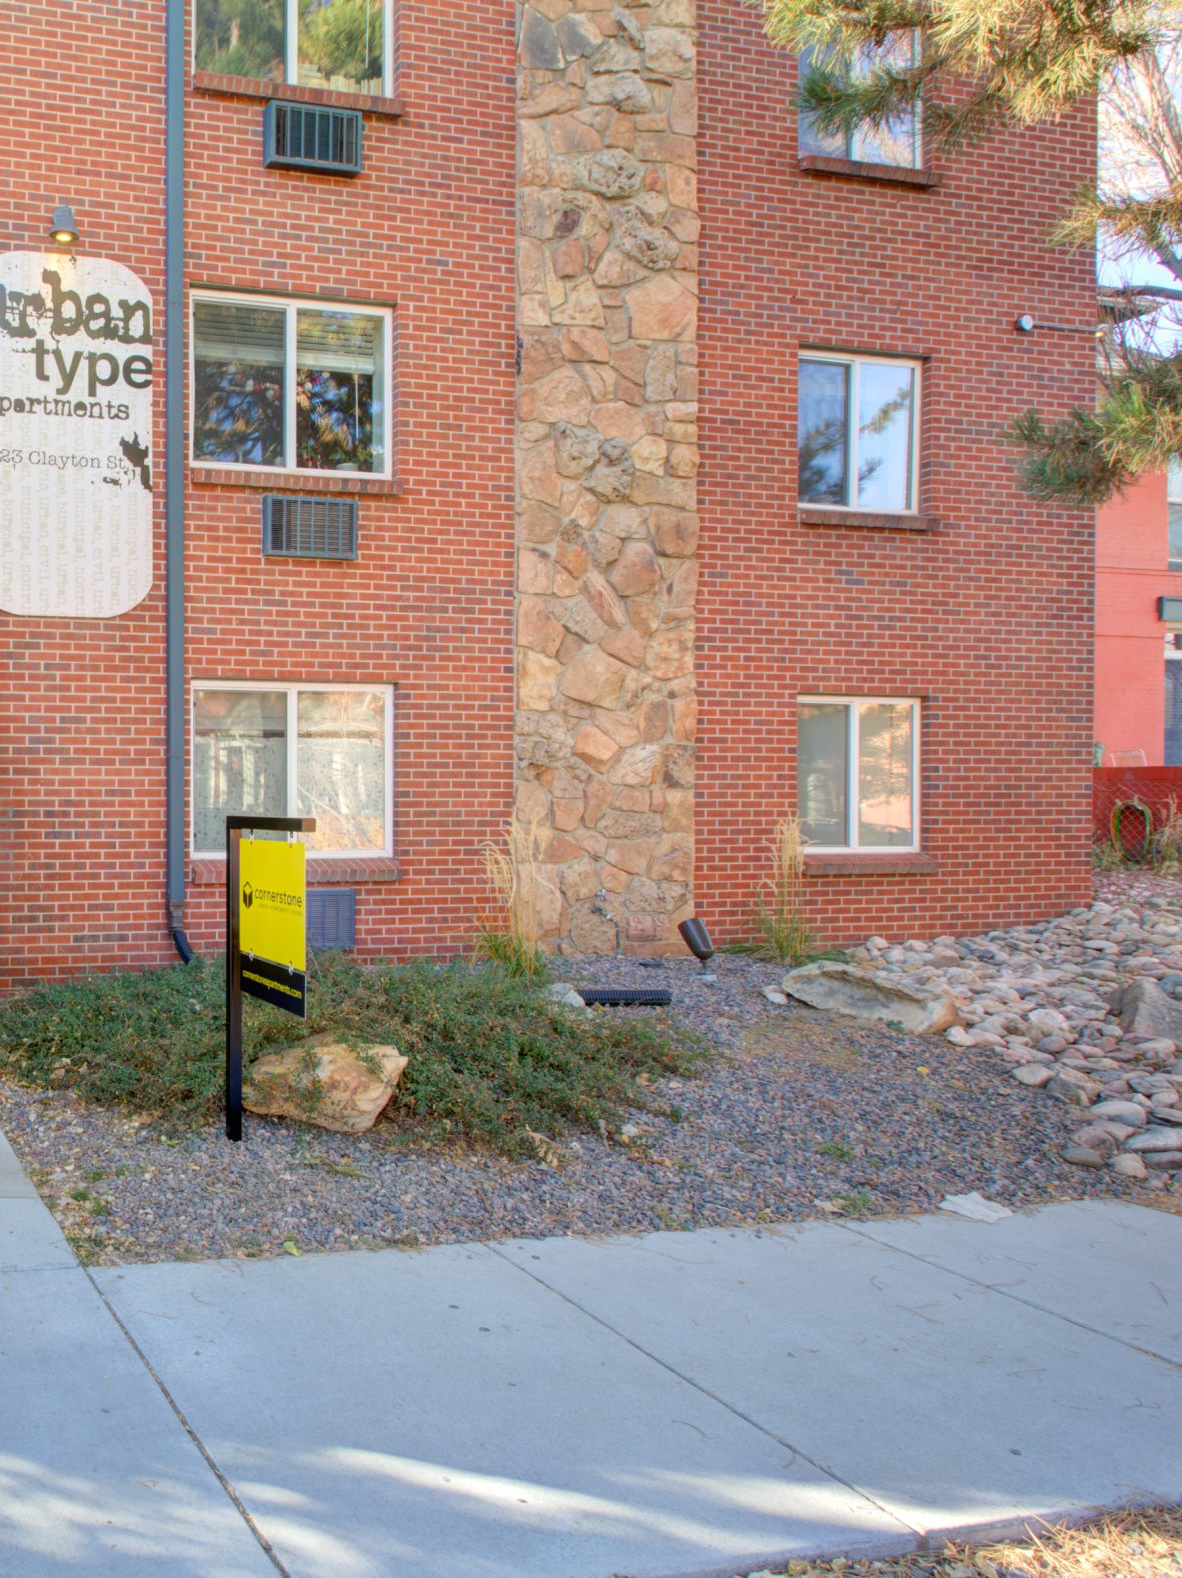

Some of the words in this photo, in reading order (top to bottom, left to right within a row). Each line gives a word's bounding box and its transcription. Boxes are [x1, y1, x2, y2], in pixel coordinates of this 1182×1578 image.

[35, 339, 153, 397] type
[28, 450, 101, 470] Clayton
[254, 888, 302, 908] cornerstone
